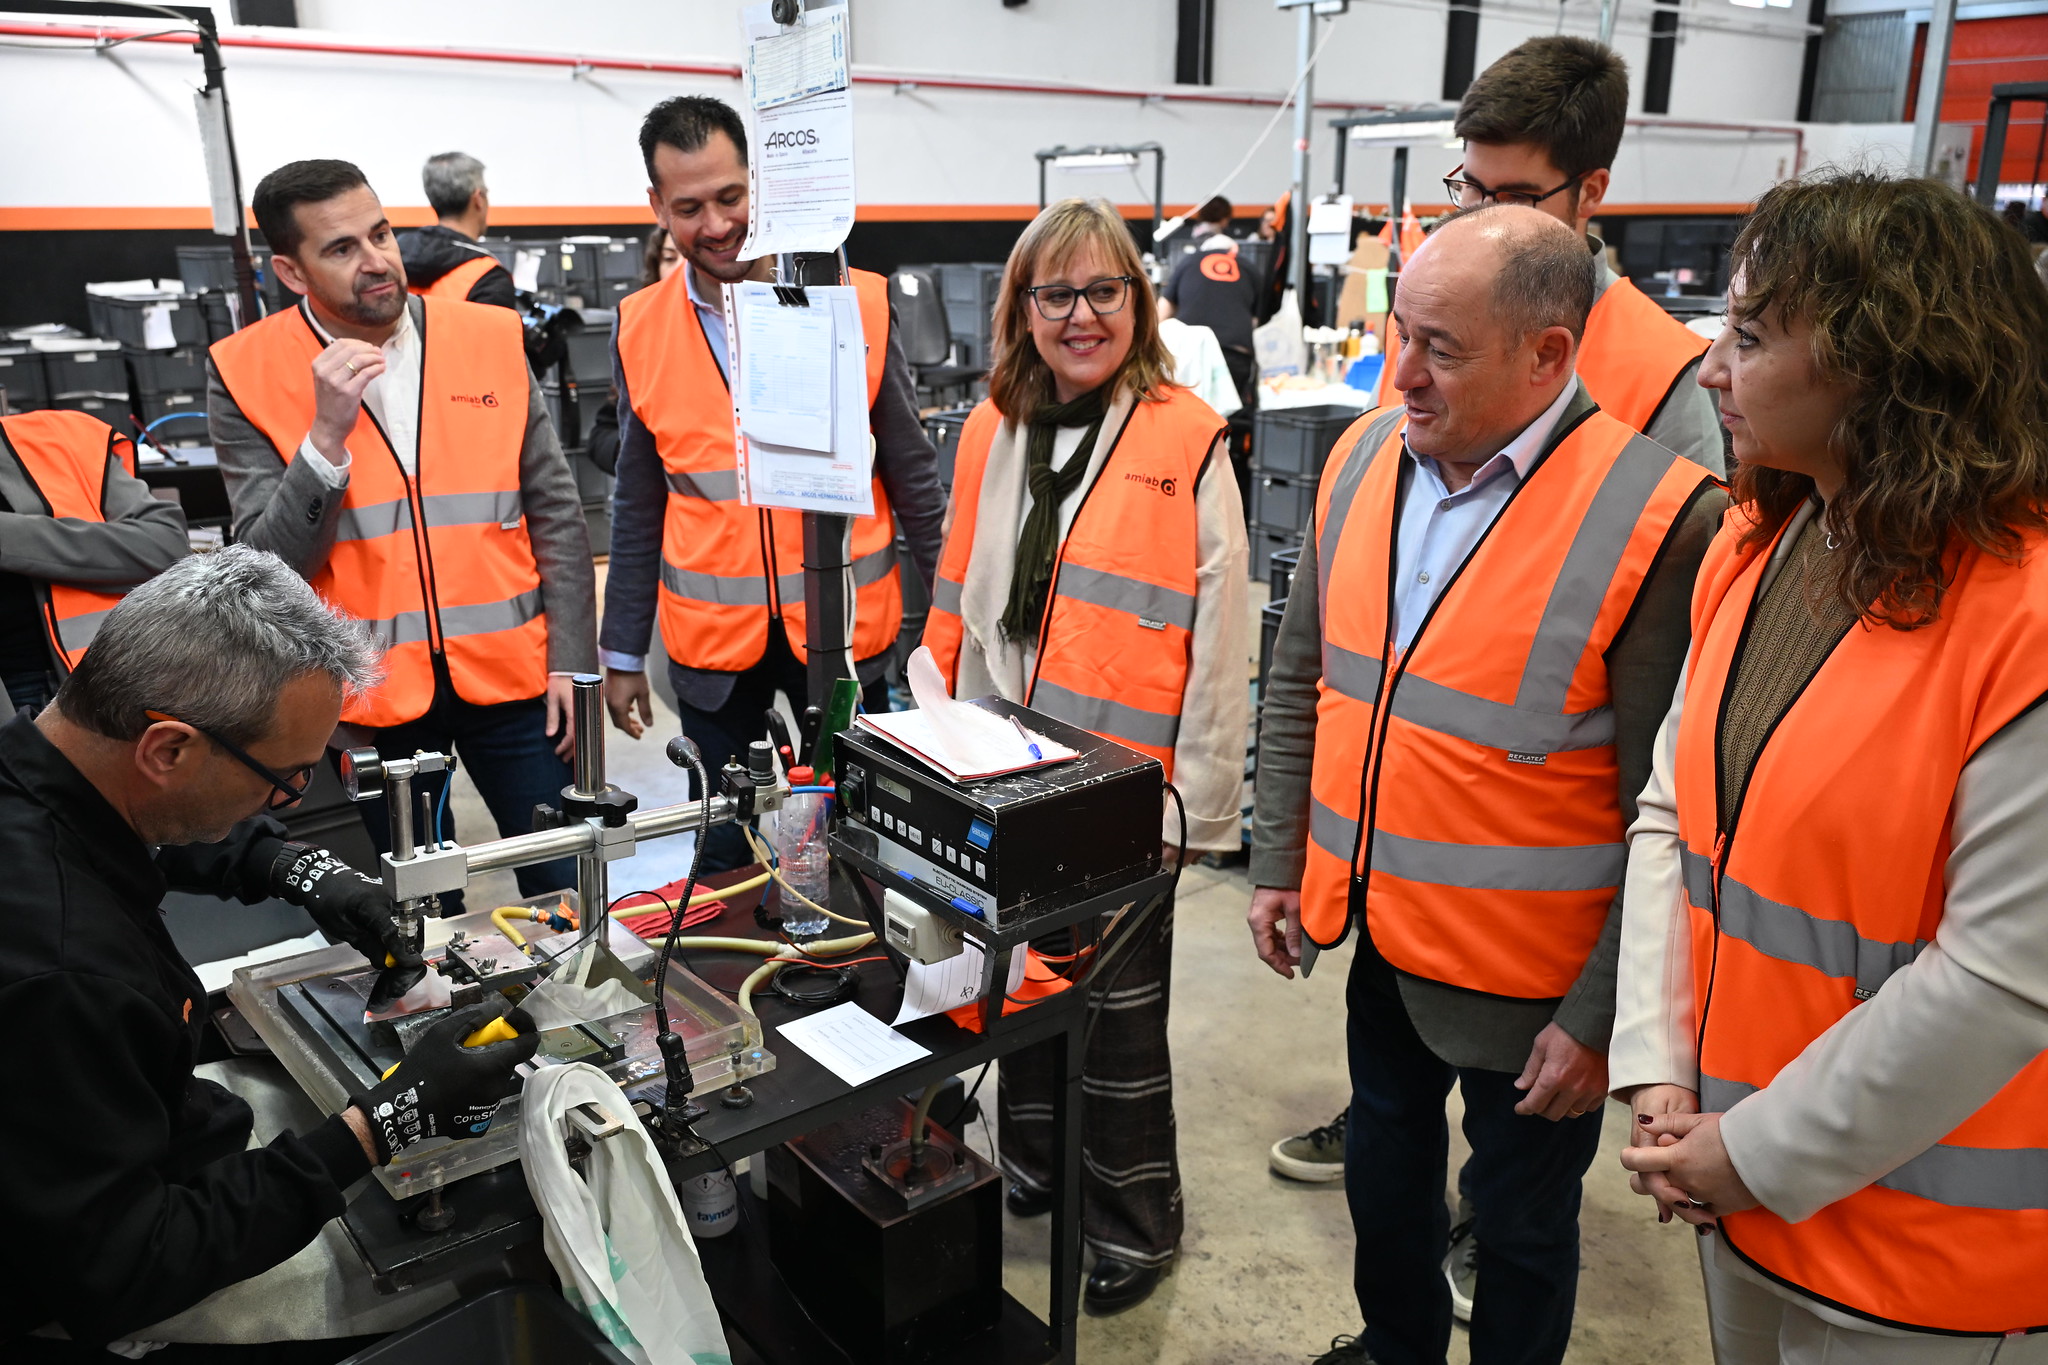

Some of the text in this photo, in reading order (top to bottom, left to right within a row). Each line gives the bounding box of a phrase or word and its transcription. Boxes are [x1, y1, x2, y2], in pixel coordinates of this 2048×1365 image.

[764, 129, 817, 150] ARCOS
[451, 394, 481, 404] amiab
[1124, 473, 1160, 487] amiab
[1508, 753, 1544, 762] REFLATEX
[935, 876, 985, 910] EU-CLASSIC
[697, 1204, 736, 1223] fayman
